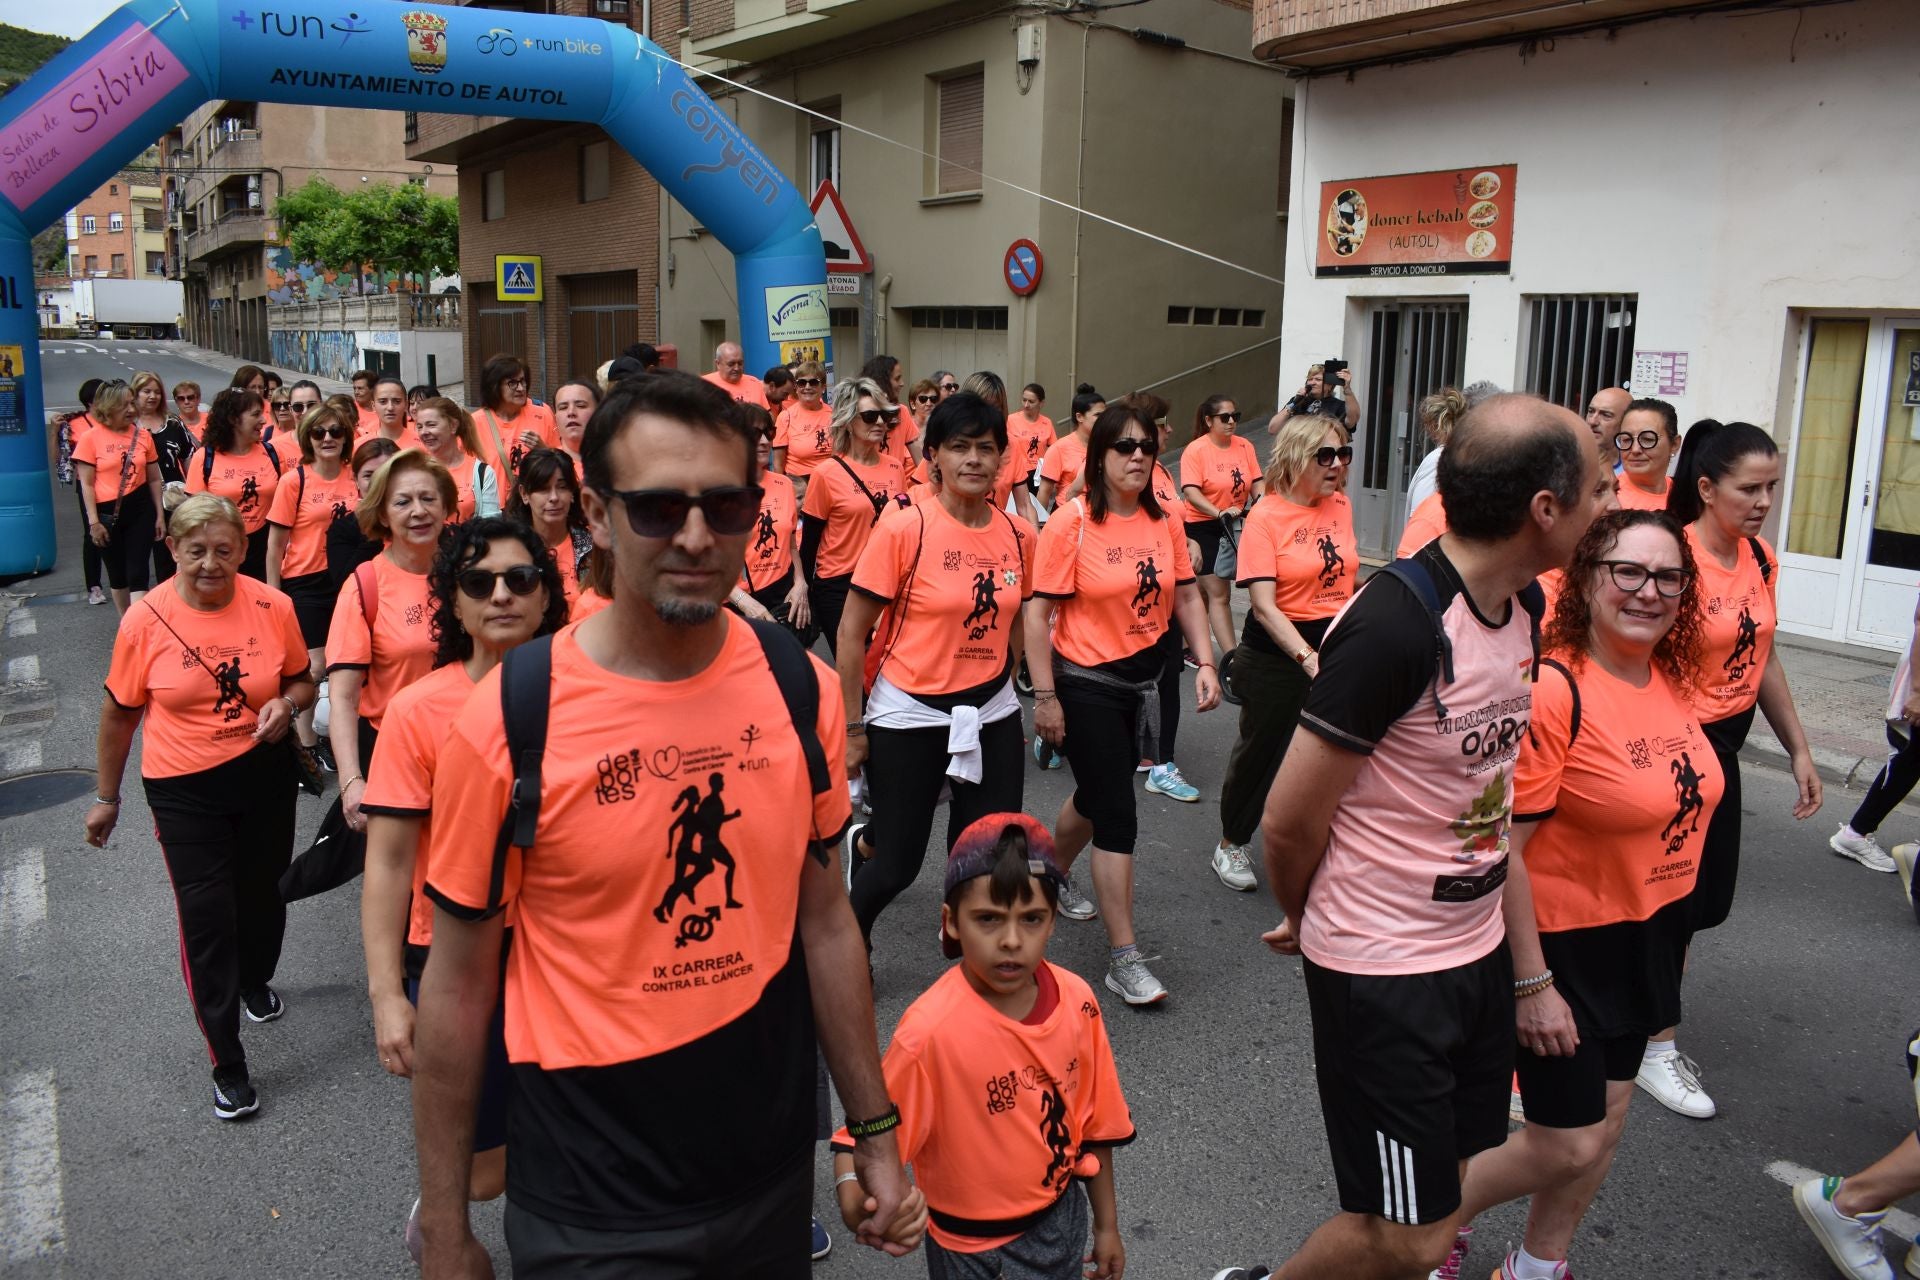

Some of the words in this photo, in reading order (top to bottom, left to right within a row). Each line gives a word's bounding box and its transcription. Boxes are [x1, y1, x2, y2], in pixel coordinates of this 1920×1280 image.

[69, 49, 165, 134] Silvia
[271, 68, 455, 97] AYUNTAMIENTO
[461, 85, 491, 100] DE
[496, 88, 568, 106] AUTOL
[3, 127, 42, 165] Salón
[41, 113, 59, 135] de
[8, 147, 61, 188] Belleza
[1369, 212, 1413, 228] doner
[1417, 207, 1464, 225] kebab
[1389, 232, 1439, 250] (AUTOL)
[1370, 266, 1401, 276] SERVICIO
[1403, 266, 1408, 274] A
[1410, 265, 1446, 275] DOMICILIO
[772, 299, 809, 327] Verona
[1435, 718, 1451, 734] VI
[1660, 859, 1692, 873] CARRERA
[653, 966, 667, 979] IX
[672, 951, 744, 976] CARRERA
[642, 978, 691, 993] CONTRA
[694, 976, 709, 987] EL
